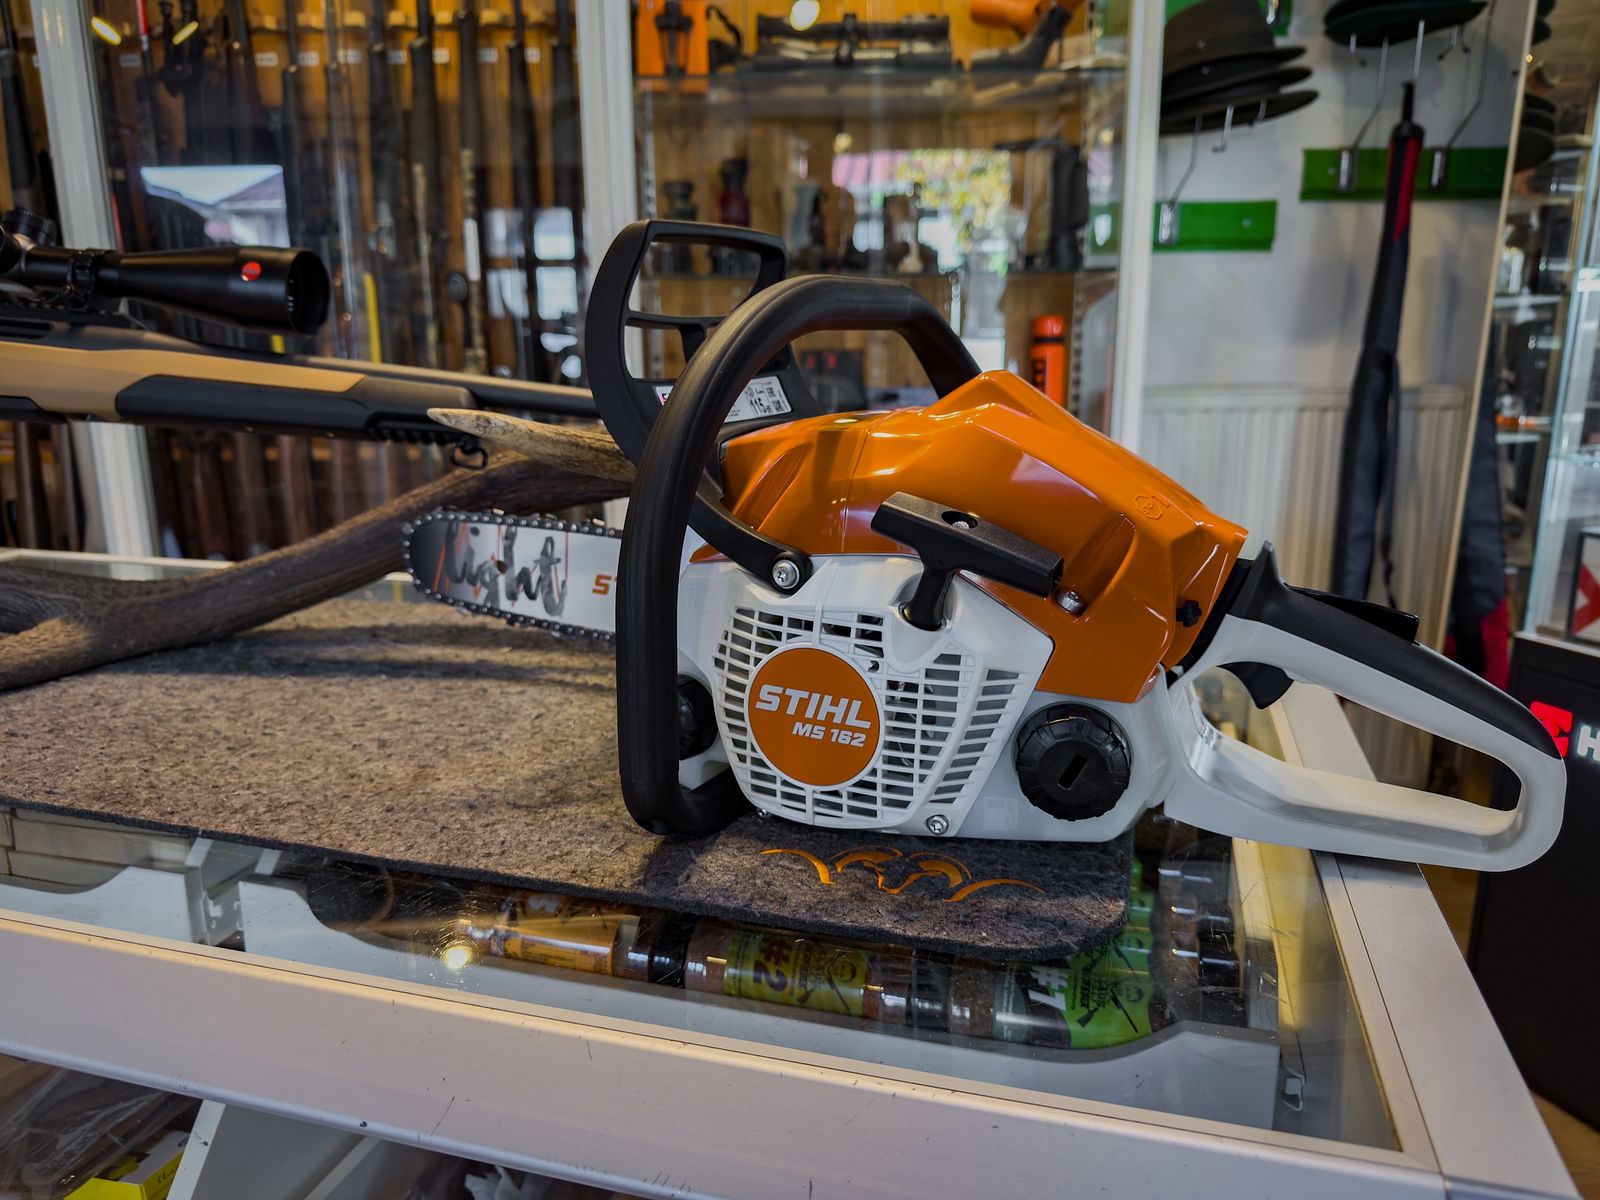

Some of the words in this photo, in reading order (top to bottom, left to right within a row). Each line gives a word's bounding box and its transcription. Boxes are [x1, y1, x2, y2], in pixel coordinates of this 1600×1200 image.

[592, 573, 618, 596] S
[755, 684, 872, 729] STIHL
[792, 721, 826, 740] MS
[830, 728, 867, 748] 162
